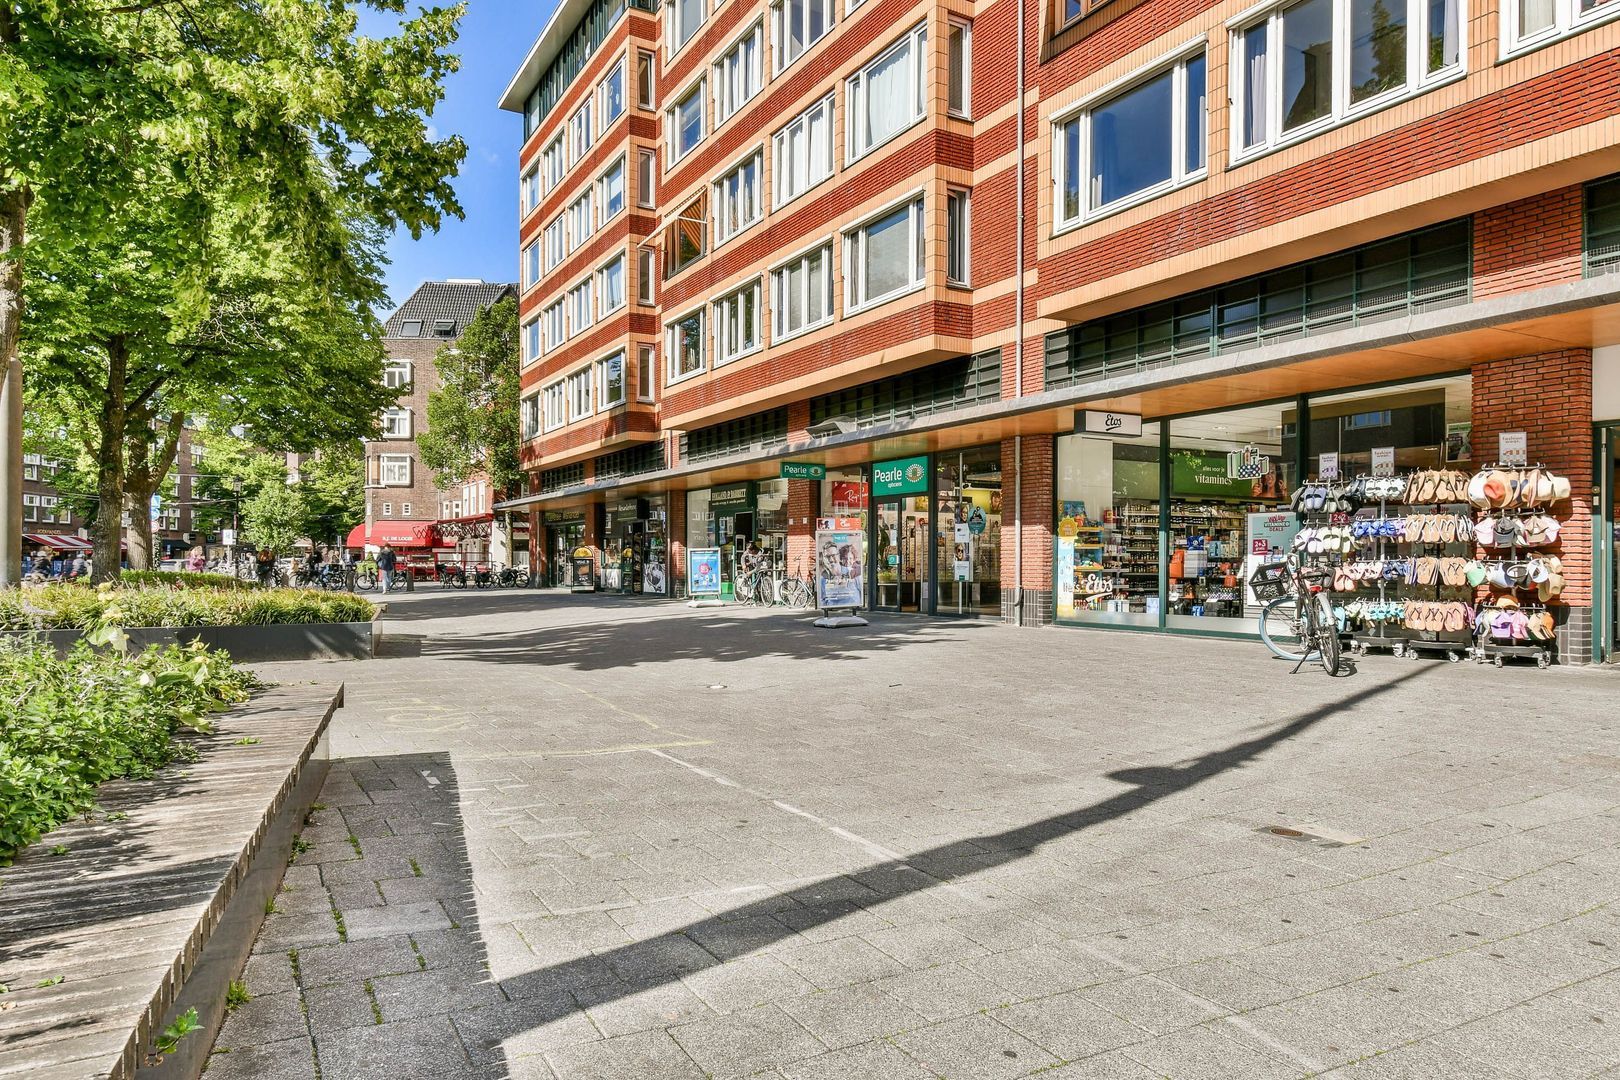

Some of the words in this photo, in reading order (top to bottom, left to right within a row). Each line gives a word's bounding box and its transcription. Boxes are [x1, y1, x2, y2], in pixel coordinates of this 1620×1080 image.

[1105, 413, 1122, 427] Etos
[784, 465, 807, 474] Pearle
[874, 467, 903, 484] Pearle
[1195, 474, 1233, 486] vitamines
[1086, 573, 1113, 595] Etos
